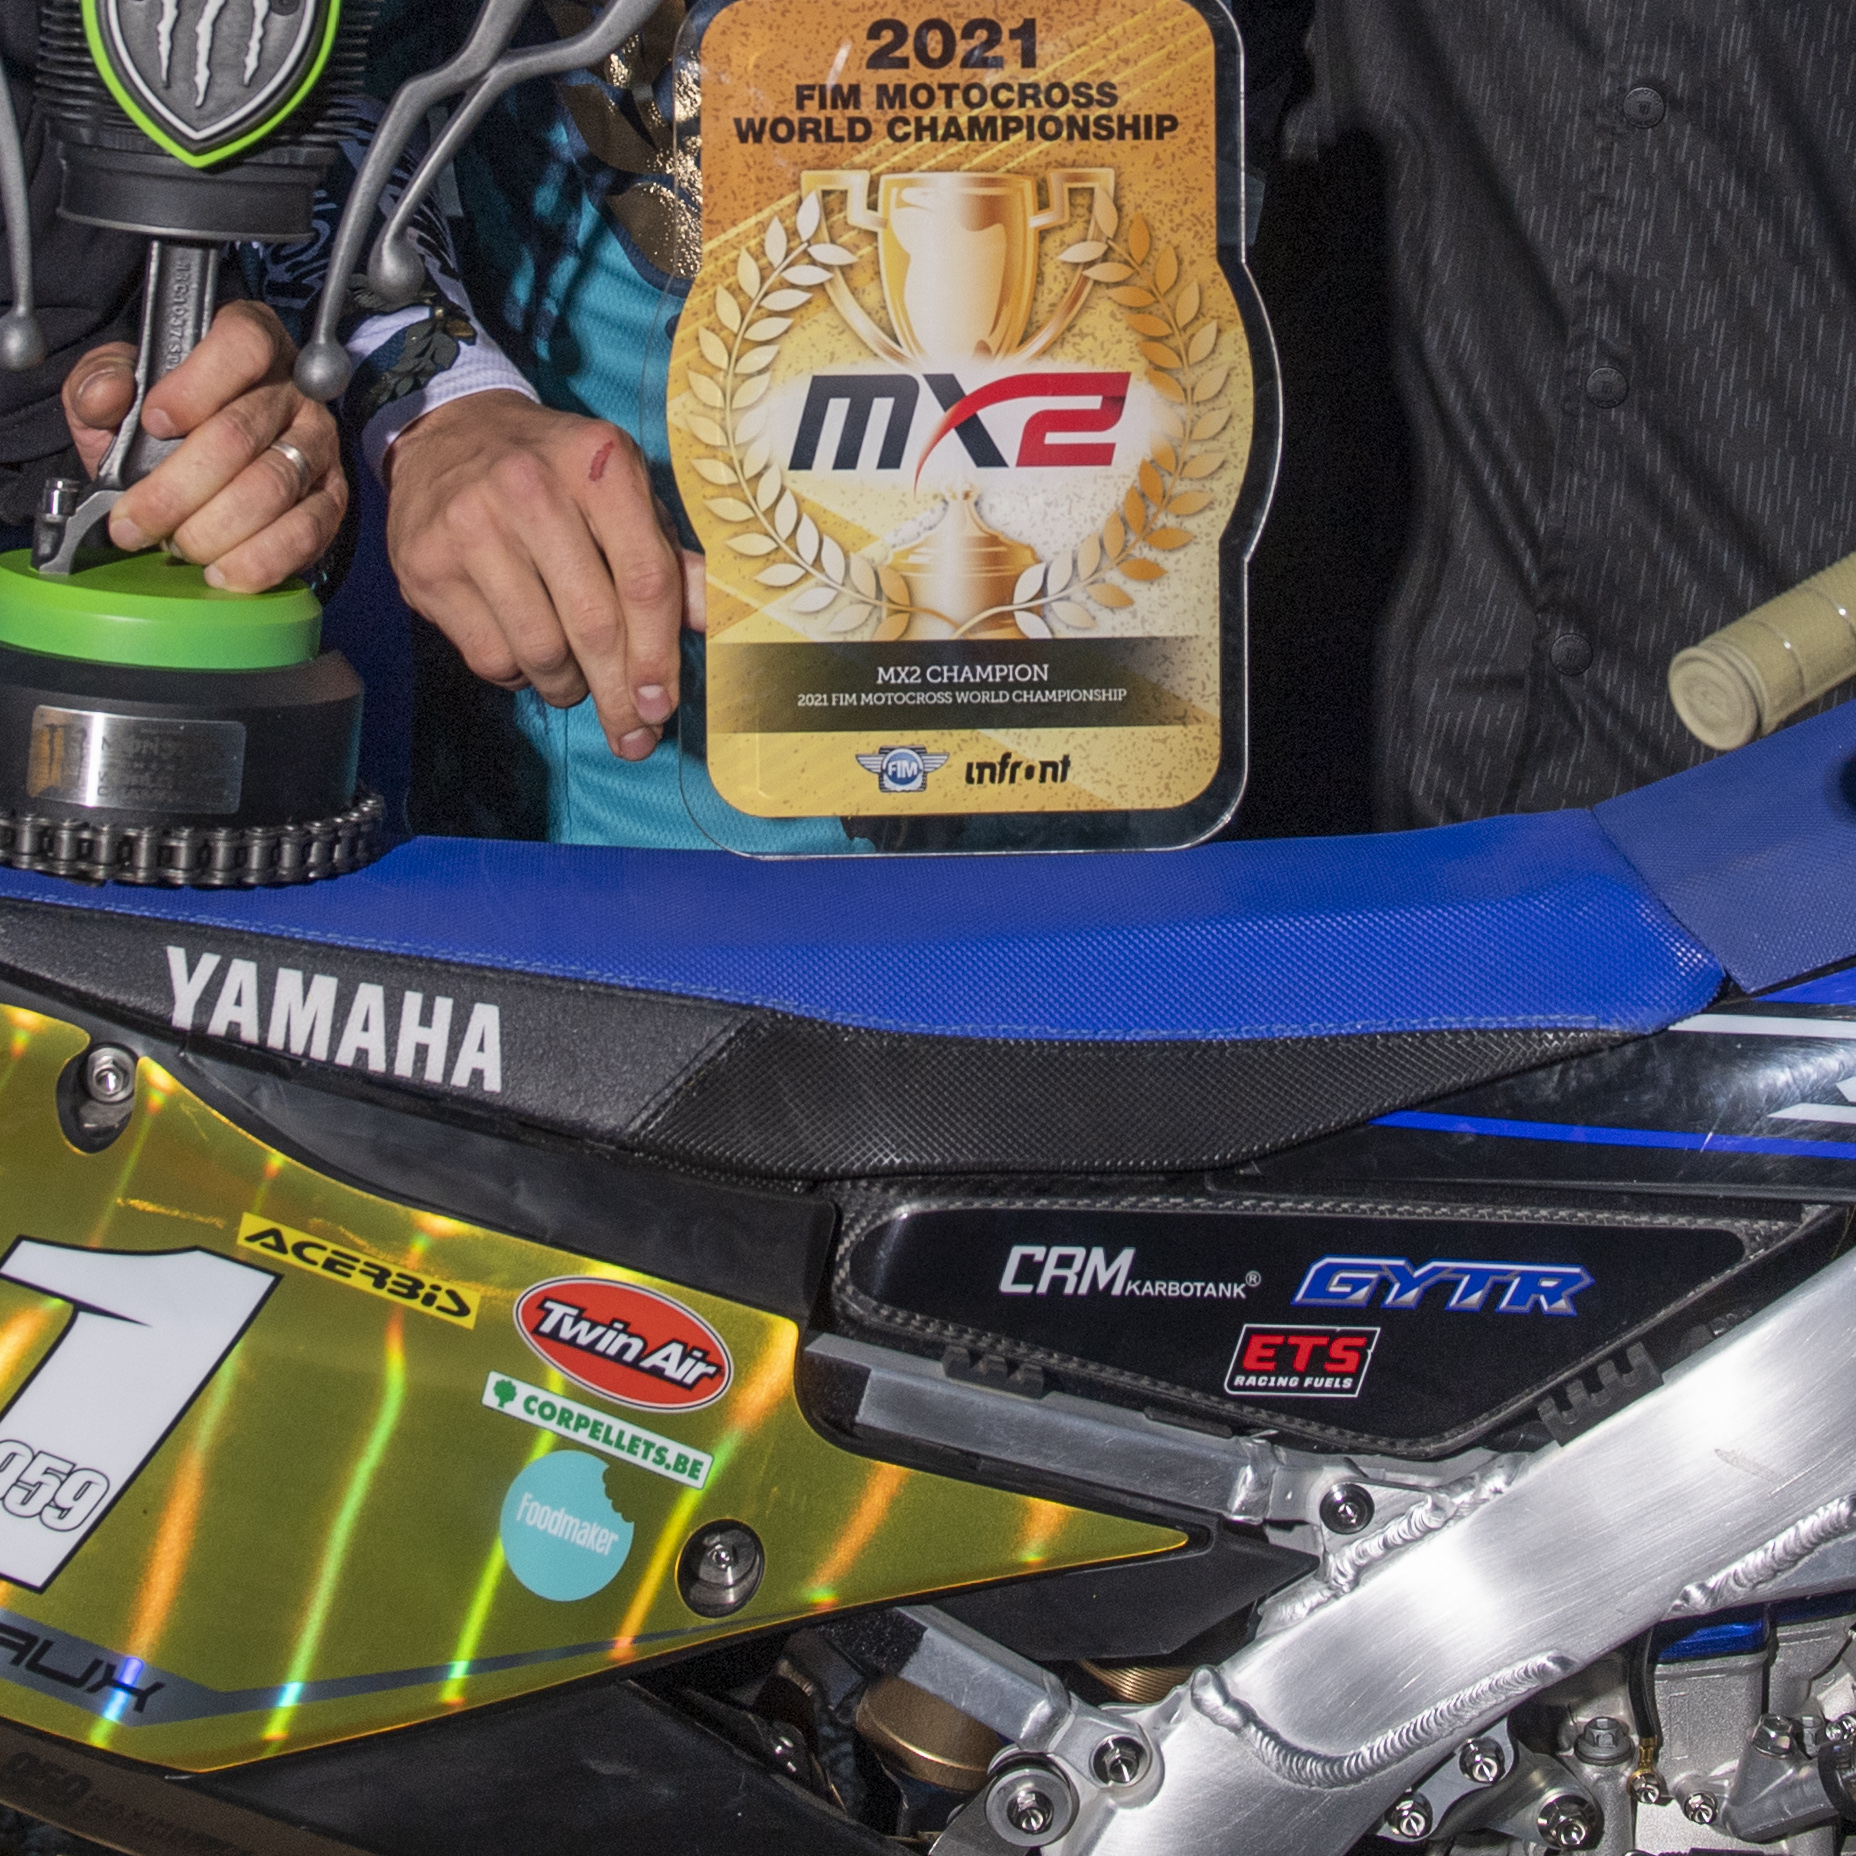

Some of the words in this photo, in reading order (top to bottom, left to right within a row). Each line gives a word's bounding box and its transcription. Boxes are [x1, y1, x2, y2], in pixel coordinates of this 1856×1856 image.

[865, 17, 1039, 71] 2021
[795, 83, 866, 111] FIM
[875, 81, 1119, 111] MOTOCROSS
[734, 116, 874, 145] WORLD
[886, 113, 1180, 144] CHAMPIONSHIP
[787, 371, 1132, 493] MX2
[797, 692, 829, 707] 2021
[831, 692, 857, 706] FIM
[860, 691, 952, 705] MOTOCROSS
[955, 690, 1009, 704] WORLD
[1012, 688, 1127, 703] CHAMPIONSHIP
[877, 666, 922, 684] MX2
[926, 664, 1049, 684] CHAMPION
[887, 760, 918, 778] FIM
[165, 944, 504, 1094] YAMAHA
[244, 1226, 474, 1320] ACERBIS
[999, 1246, 1137, 1296] CRM
[1291, 1255, 1596, 1317] GYTR
[539, 1299, 645, 1363] Twin
[639, 1340, 718, 1386] Air
[1243, 1334, 1367, 1374] ETS
[1234, 1374, 1299, 1388] RACING
[1303, 1375, 1353, 1390] FUELS
[522, 1394, 705, 1482] CORPELLETS.BE
[516, 1491, 620, 1557] Foodmaker
